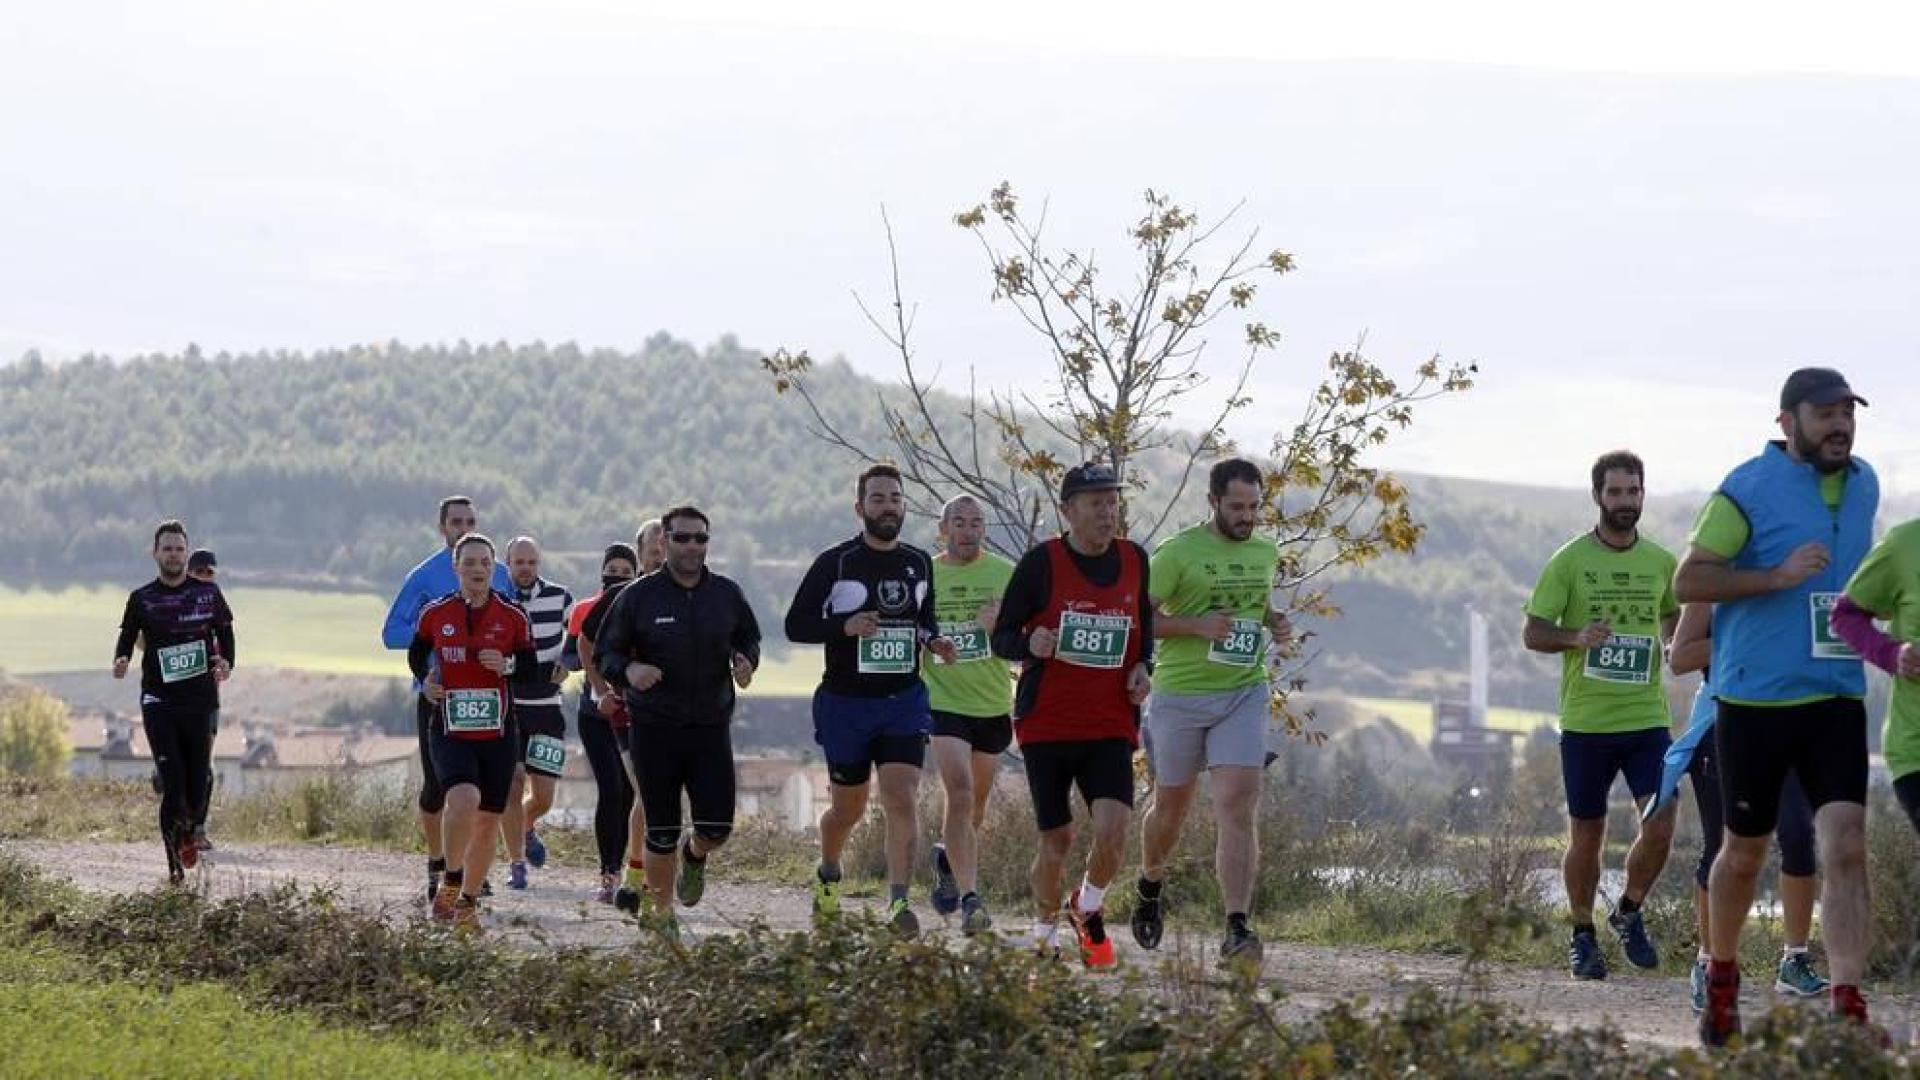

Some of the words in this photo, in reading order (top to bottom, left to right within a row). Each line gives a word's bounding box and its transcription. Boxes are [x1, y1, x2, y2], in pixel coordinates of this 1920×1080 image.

[870, 641, 905, 660] 808
[953, 633, 978, 650] 32
[1071, 629, 1115, 653] 881
[1224, 632, 1255, 653] 843
[170, 652, 197, 670] 907
[441, 647, 466, 662] RUN
[1601, 647, 1637, 669] 841
[457, 701, 490, 719] 862
[534, 744, 562, 763] 910
